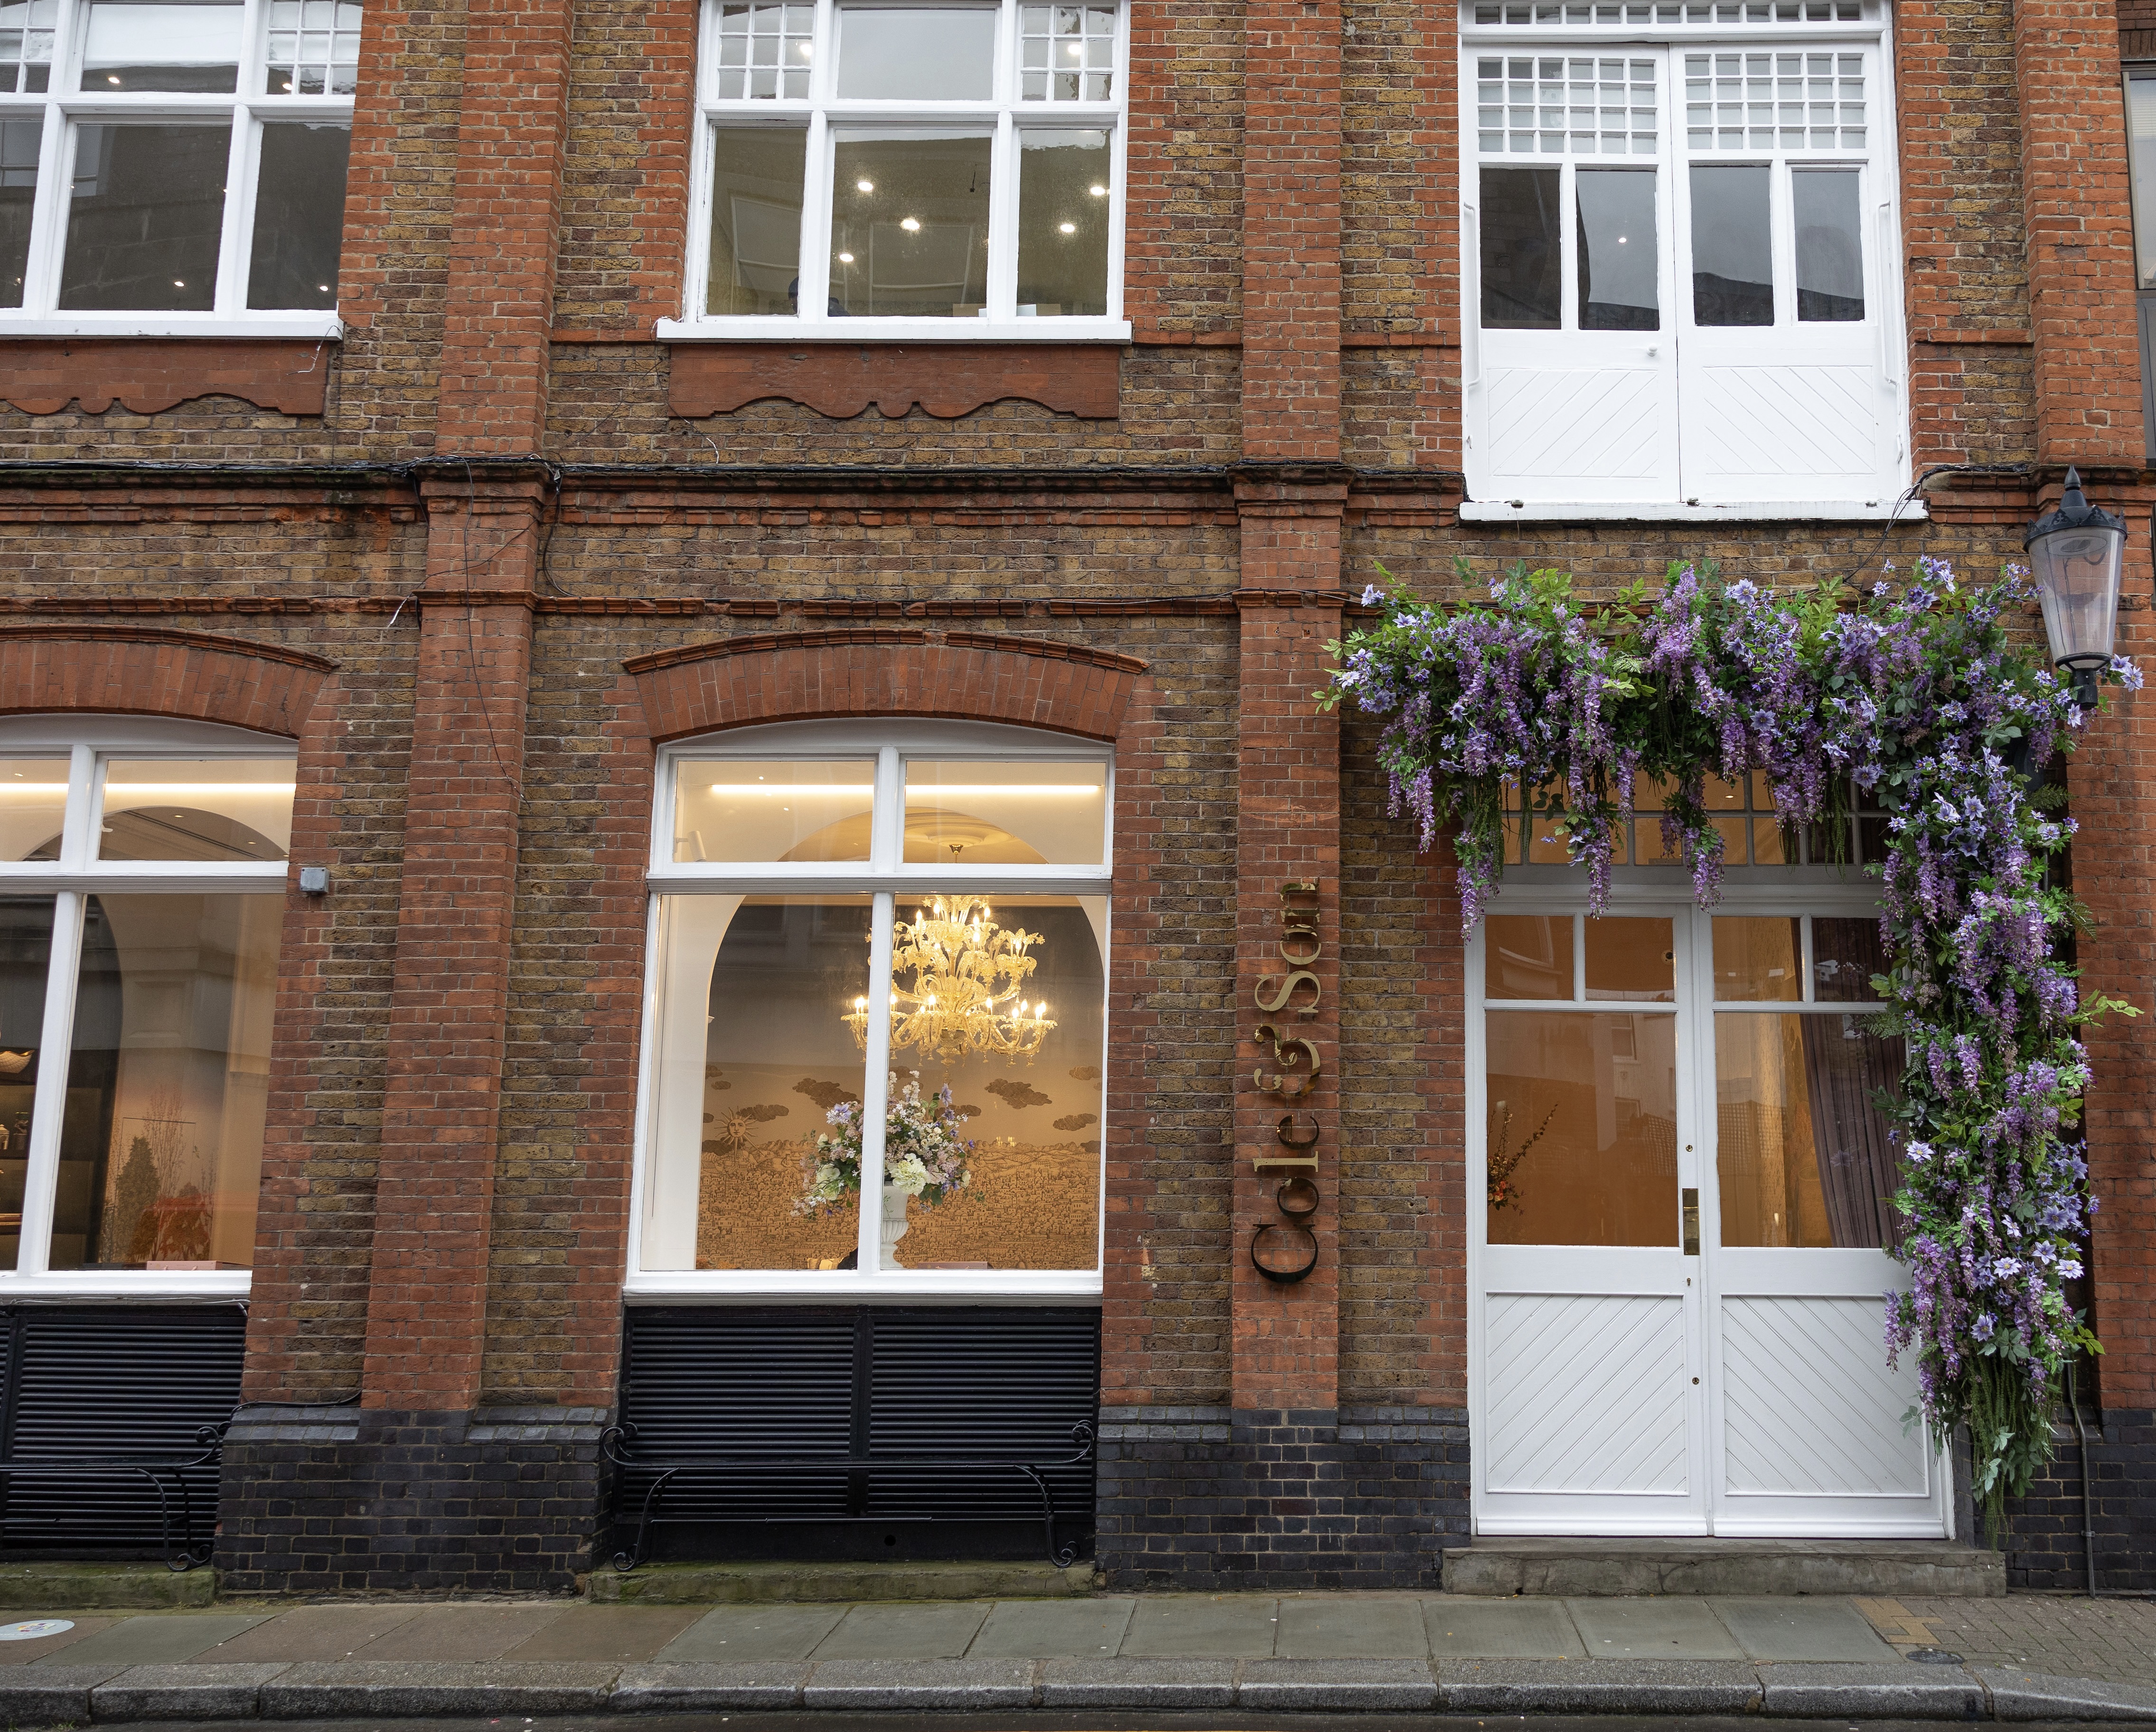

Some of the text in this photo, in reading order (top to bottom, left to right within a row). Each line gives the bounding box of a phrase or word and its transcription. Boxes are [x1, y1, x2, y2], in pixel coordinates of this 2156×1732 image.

[1251, 877, 1321, 1284] Cole & Son
